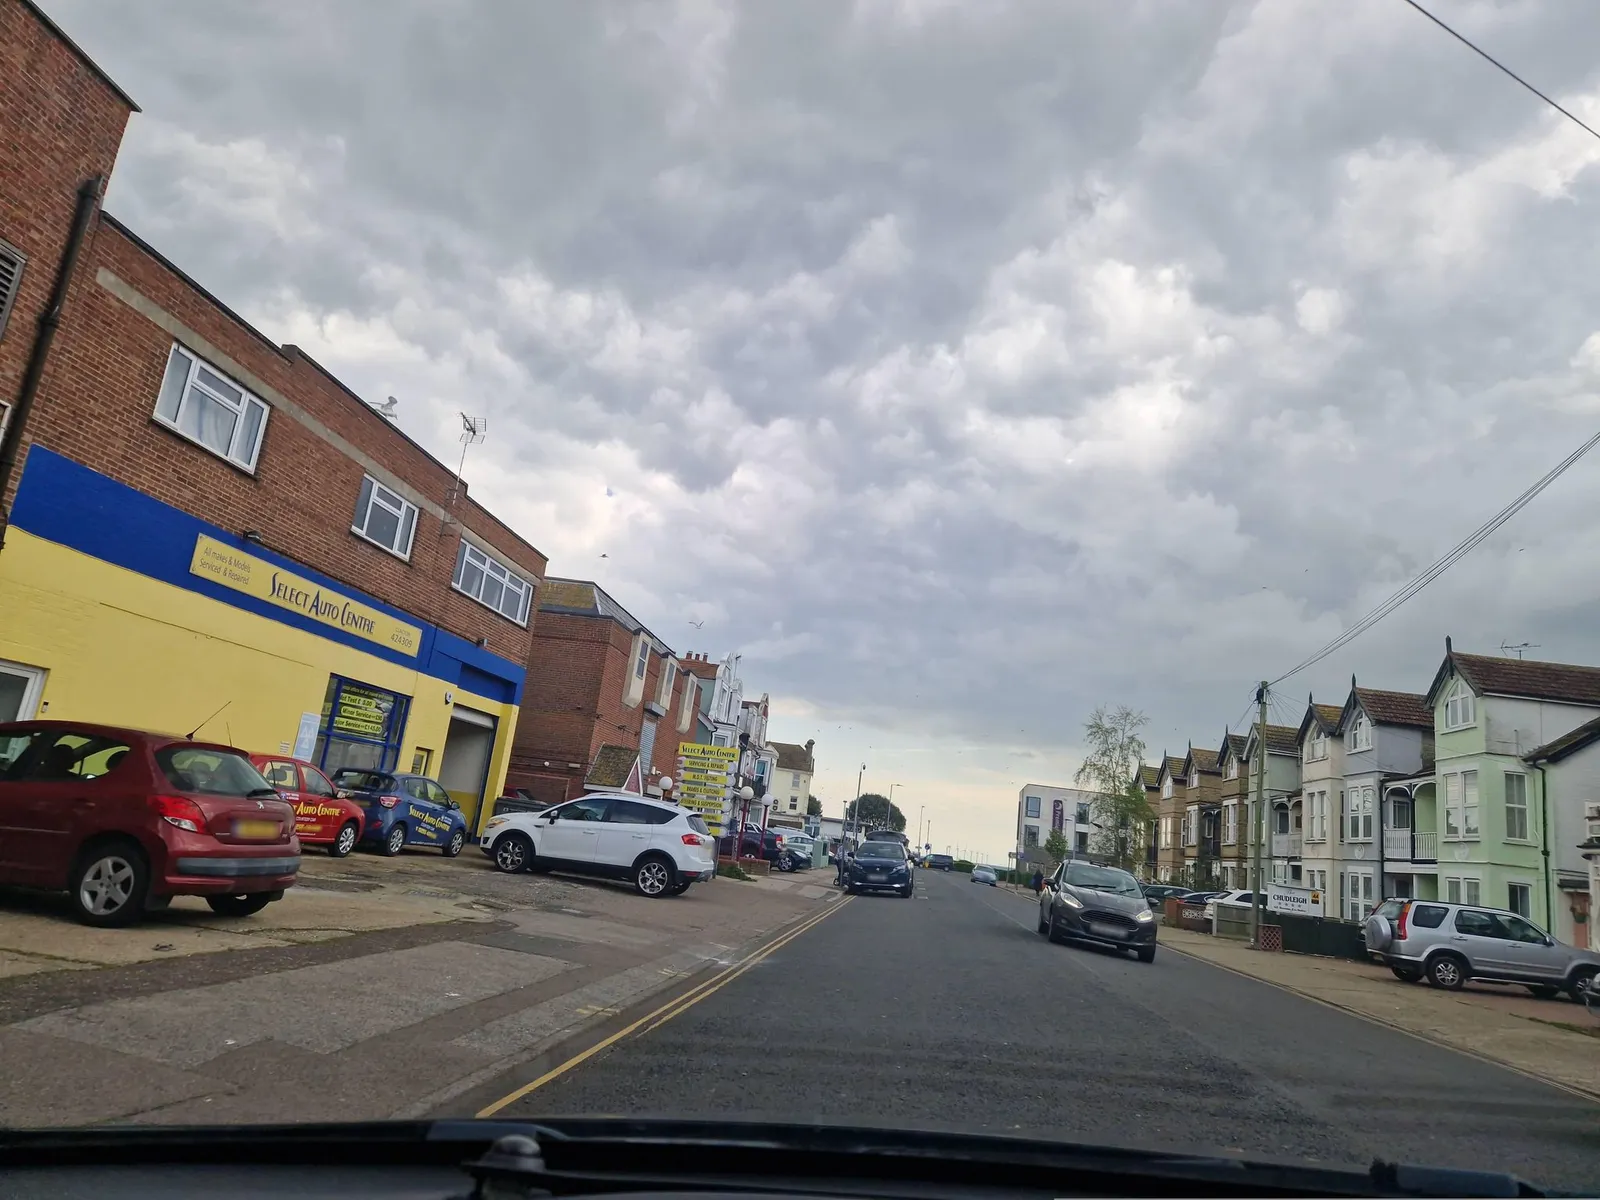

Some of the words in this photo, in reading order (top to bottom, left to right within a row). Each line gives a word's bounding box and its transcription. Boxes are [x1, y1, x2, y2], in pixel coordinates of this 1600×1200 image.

[204, 547, 212, 556] All
[212, 551, 228, 564] makes
[228, 556, 233, 565] &
[233, 559, 251, 573] Models
[200, 558, 221, 573] Serviced
[223, 567, 228, 576] &
[228, 569, 250, 585] Repaired
[269, 572, 310, 609] SELECT
[308, 590, 339, 617] AUTO
[341, 601, 376, 634] CENTRE
[390, 633, 413, 649] 424309
[355, 710, 372, 719] Service
[335, 719, 345, 727] ajor
[345, 720, 361, 728] Service
[296, 801, 317, 815] AUTO
[317, 803, 341, 817] CENTRE
[1272, 894, 1307, 905] CHUDLEIGH
